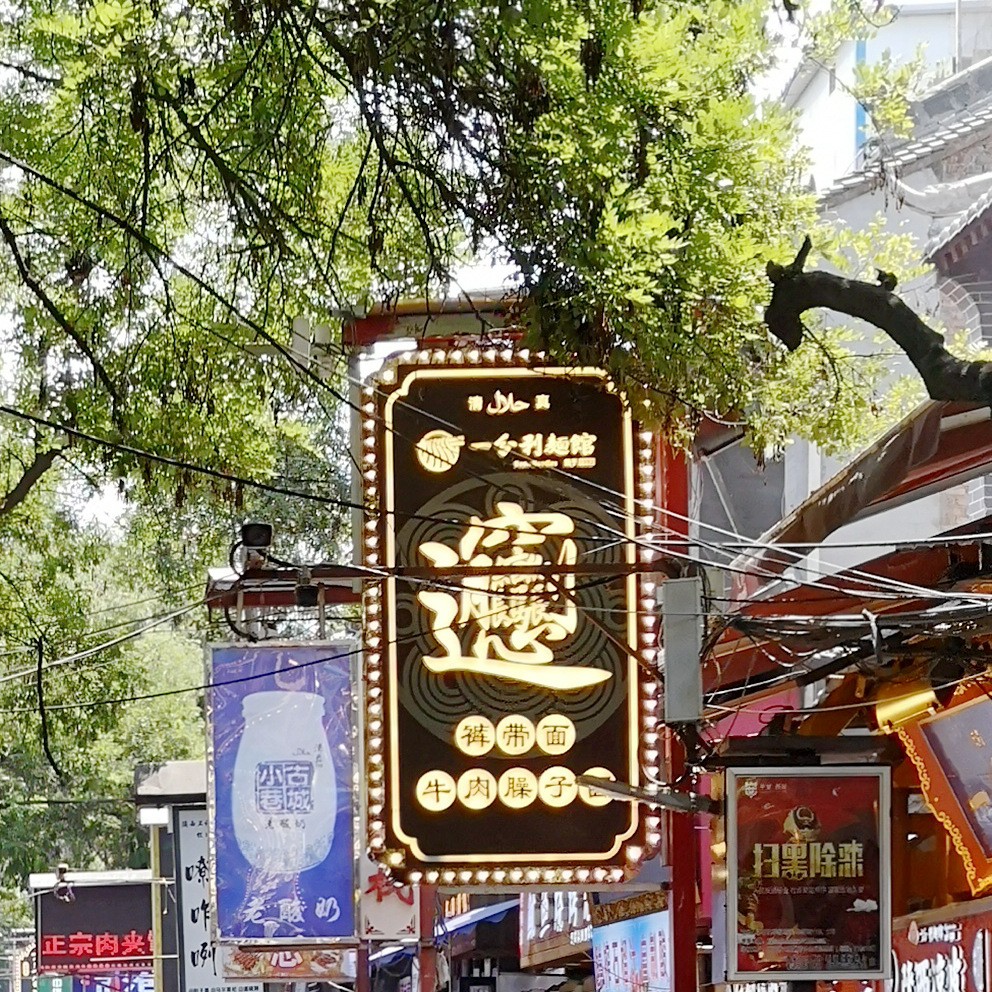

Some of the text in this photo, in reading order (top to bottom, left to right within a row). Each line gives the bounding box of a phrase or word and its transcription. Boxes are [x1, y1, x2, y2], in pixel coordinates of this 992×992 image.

[463, 722, 570, 748] 裤带面
[243, 896, 341, 924] 老酸奶
[42, 930, 154, 956] 正宗肉夹
